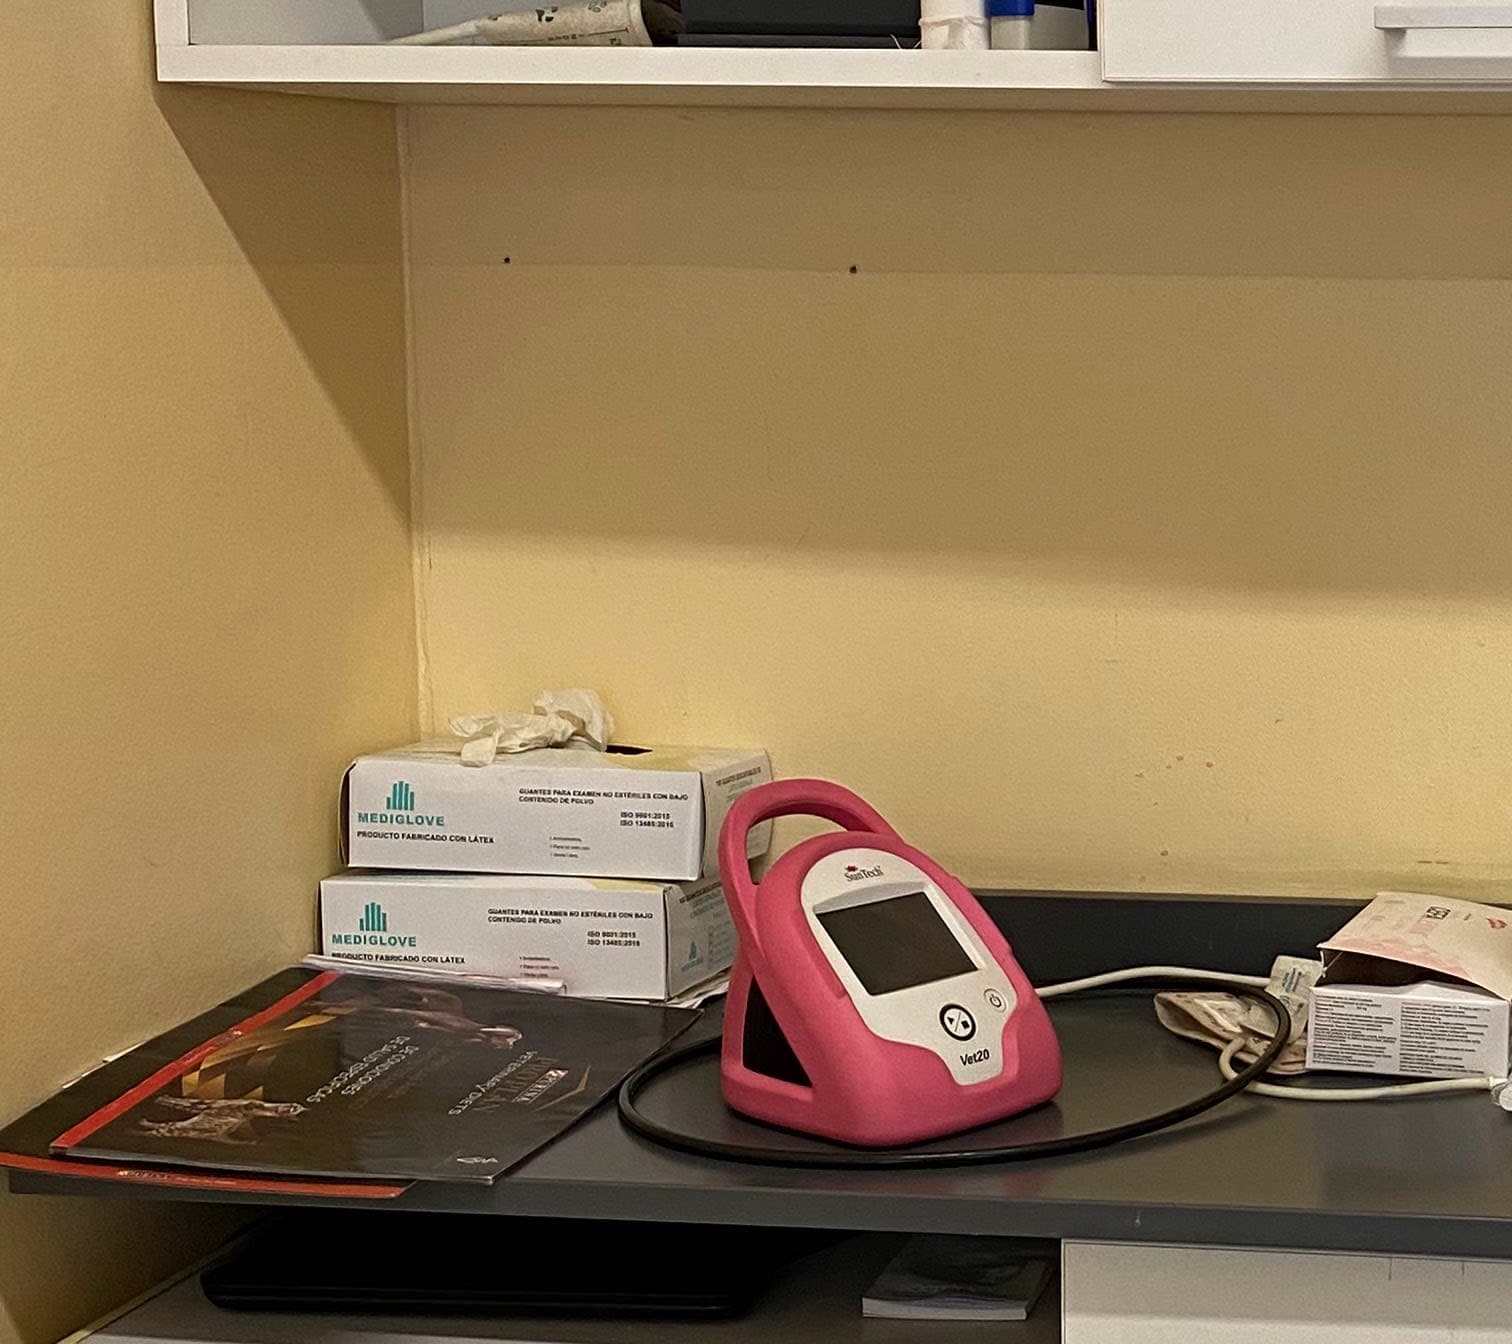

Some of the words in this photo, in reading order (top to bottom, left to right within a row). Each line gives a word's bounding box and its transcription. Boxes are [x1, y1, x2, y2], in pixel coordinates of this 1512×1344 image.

[357, 812, 445, 826] MEDIGLOVE
[357, 831, 400, 840] PRODUCTO
[401, 832, 447, 842] FABRICADO
[449, 835, 467, 843] CON
[331, 934, 417, 947] MEDIGLOVE
[375, 955, 420, 963] FABRICADO
[421, 956, 438, 964] CON
[959, 1048, 990, 1066] Vet20
